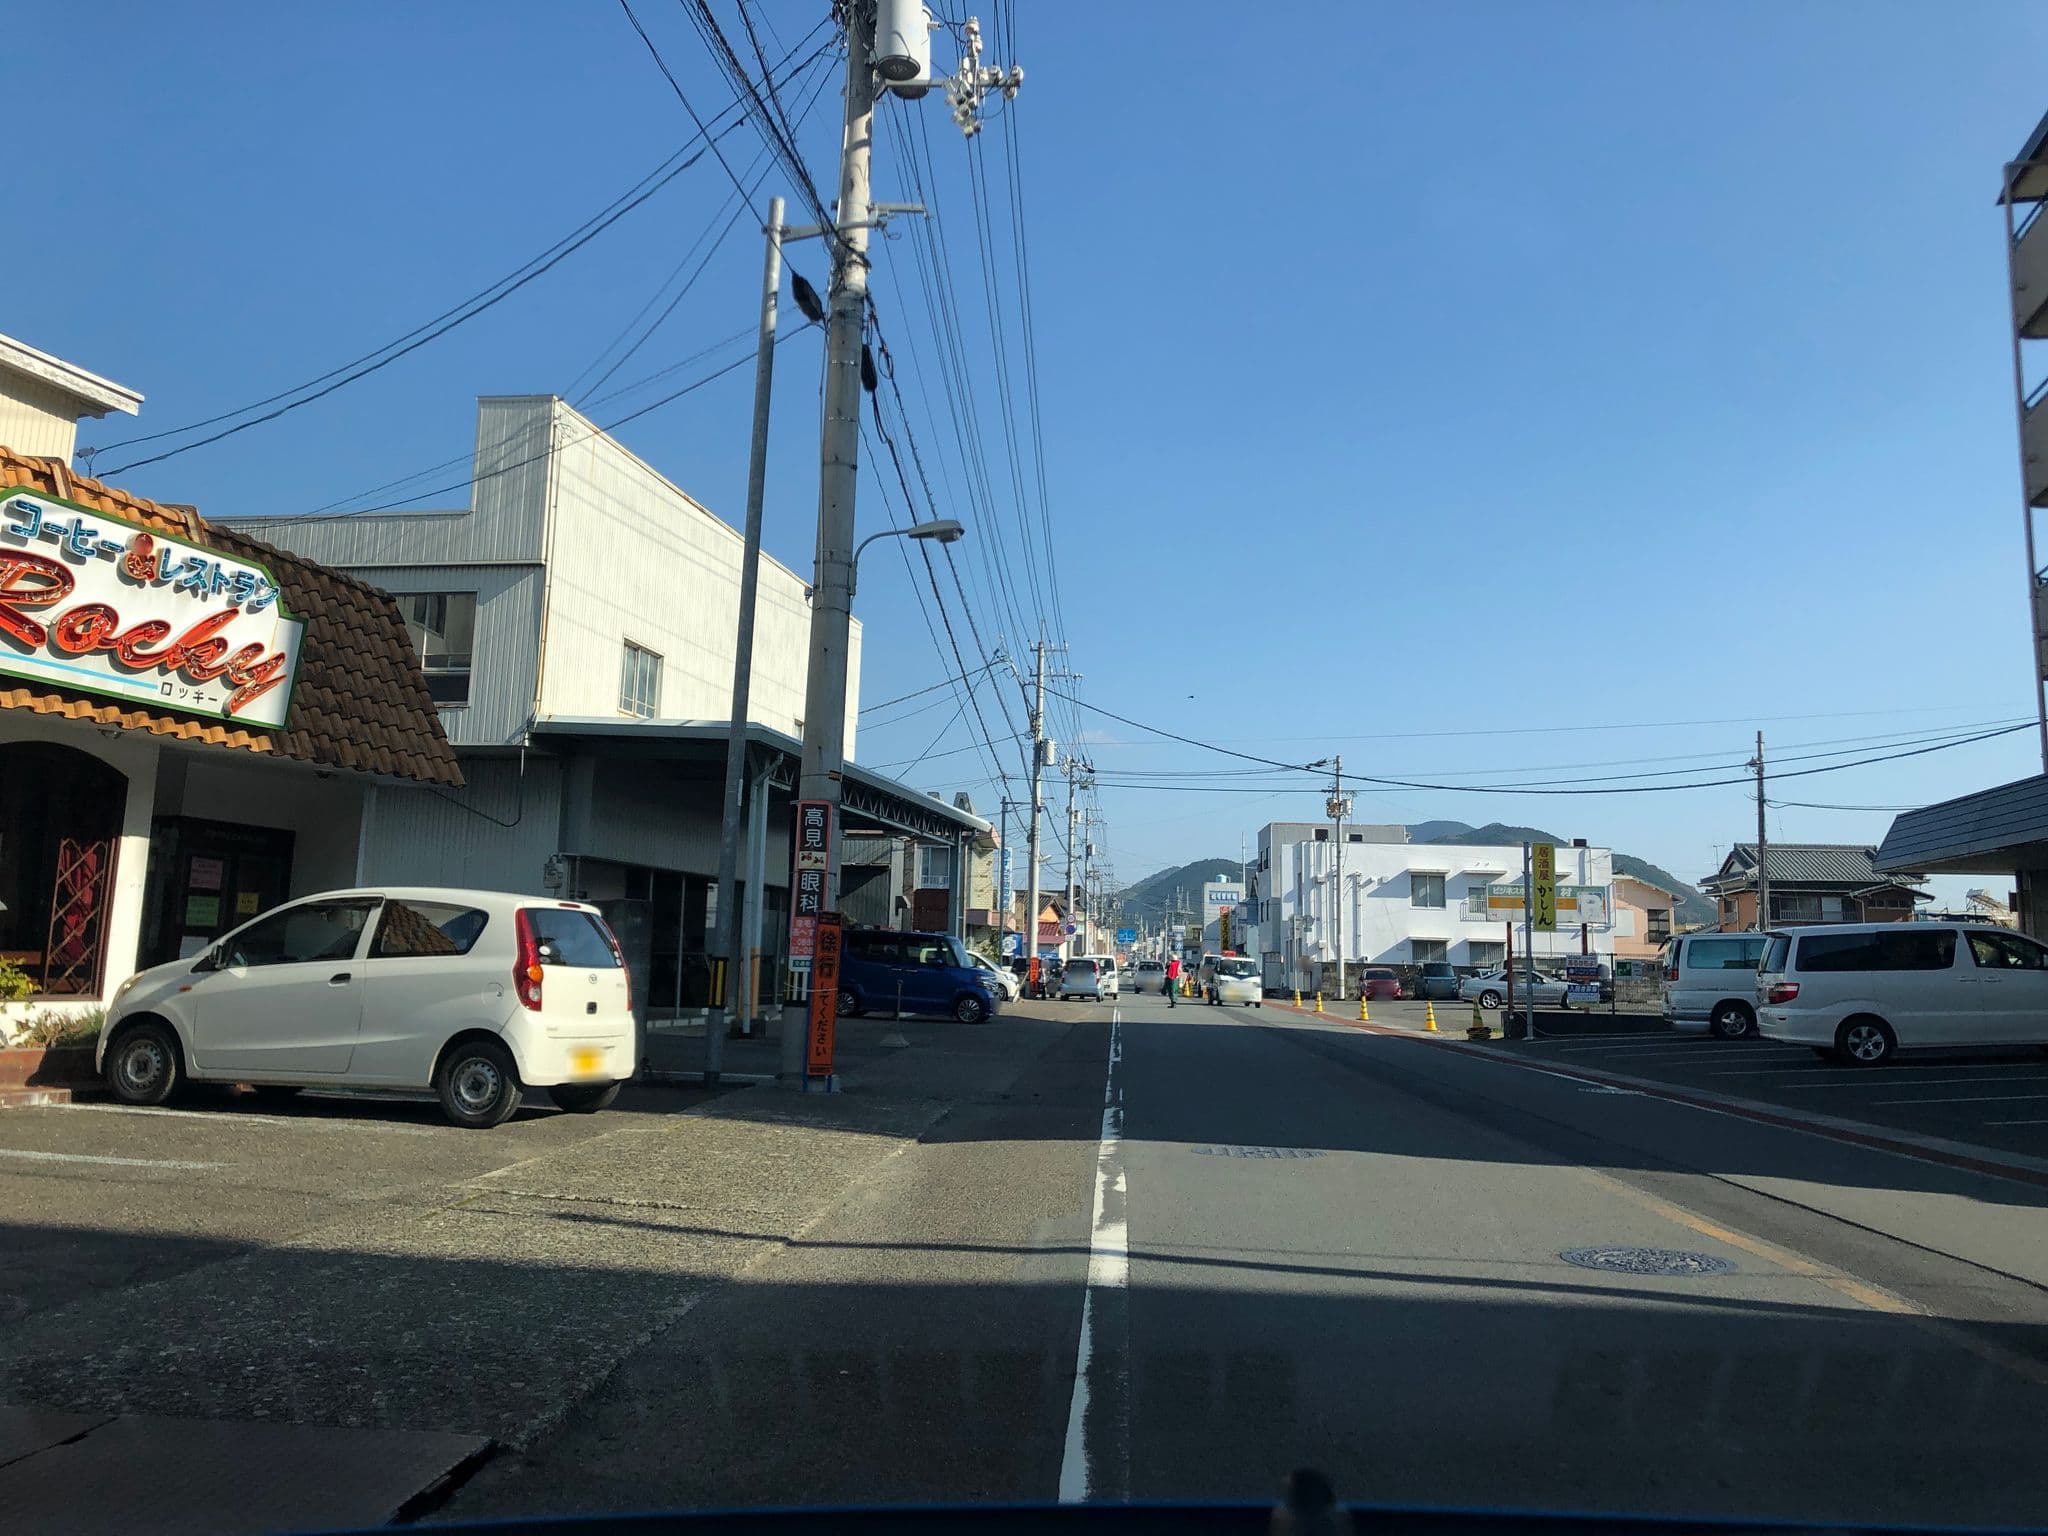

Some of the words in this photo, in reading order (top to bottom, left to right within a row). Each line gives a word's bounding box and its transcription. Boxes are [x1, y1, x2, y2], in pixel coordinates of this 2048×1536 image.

[0, 548, 287, 714] Rocky
[160, 681, 218, 705] ロッキー
[804, 808, 824, 849] 高見
[1538, 846, 1550, 881] 居酒屋
[799, 872, 821, 914] 眼科
[1537, 885, 1553, 927] かしん
